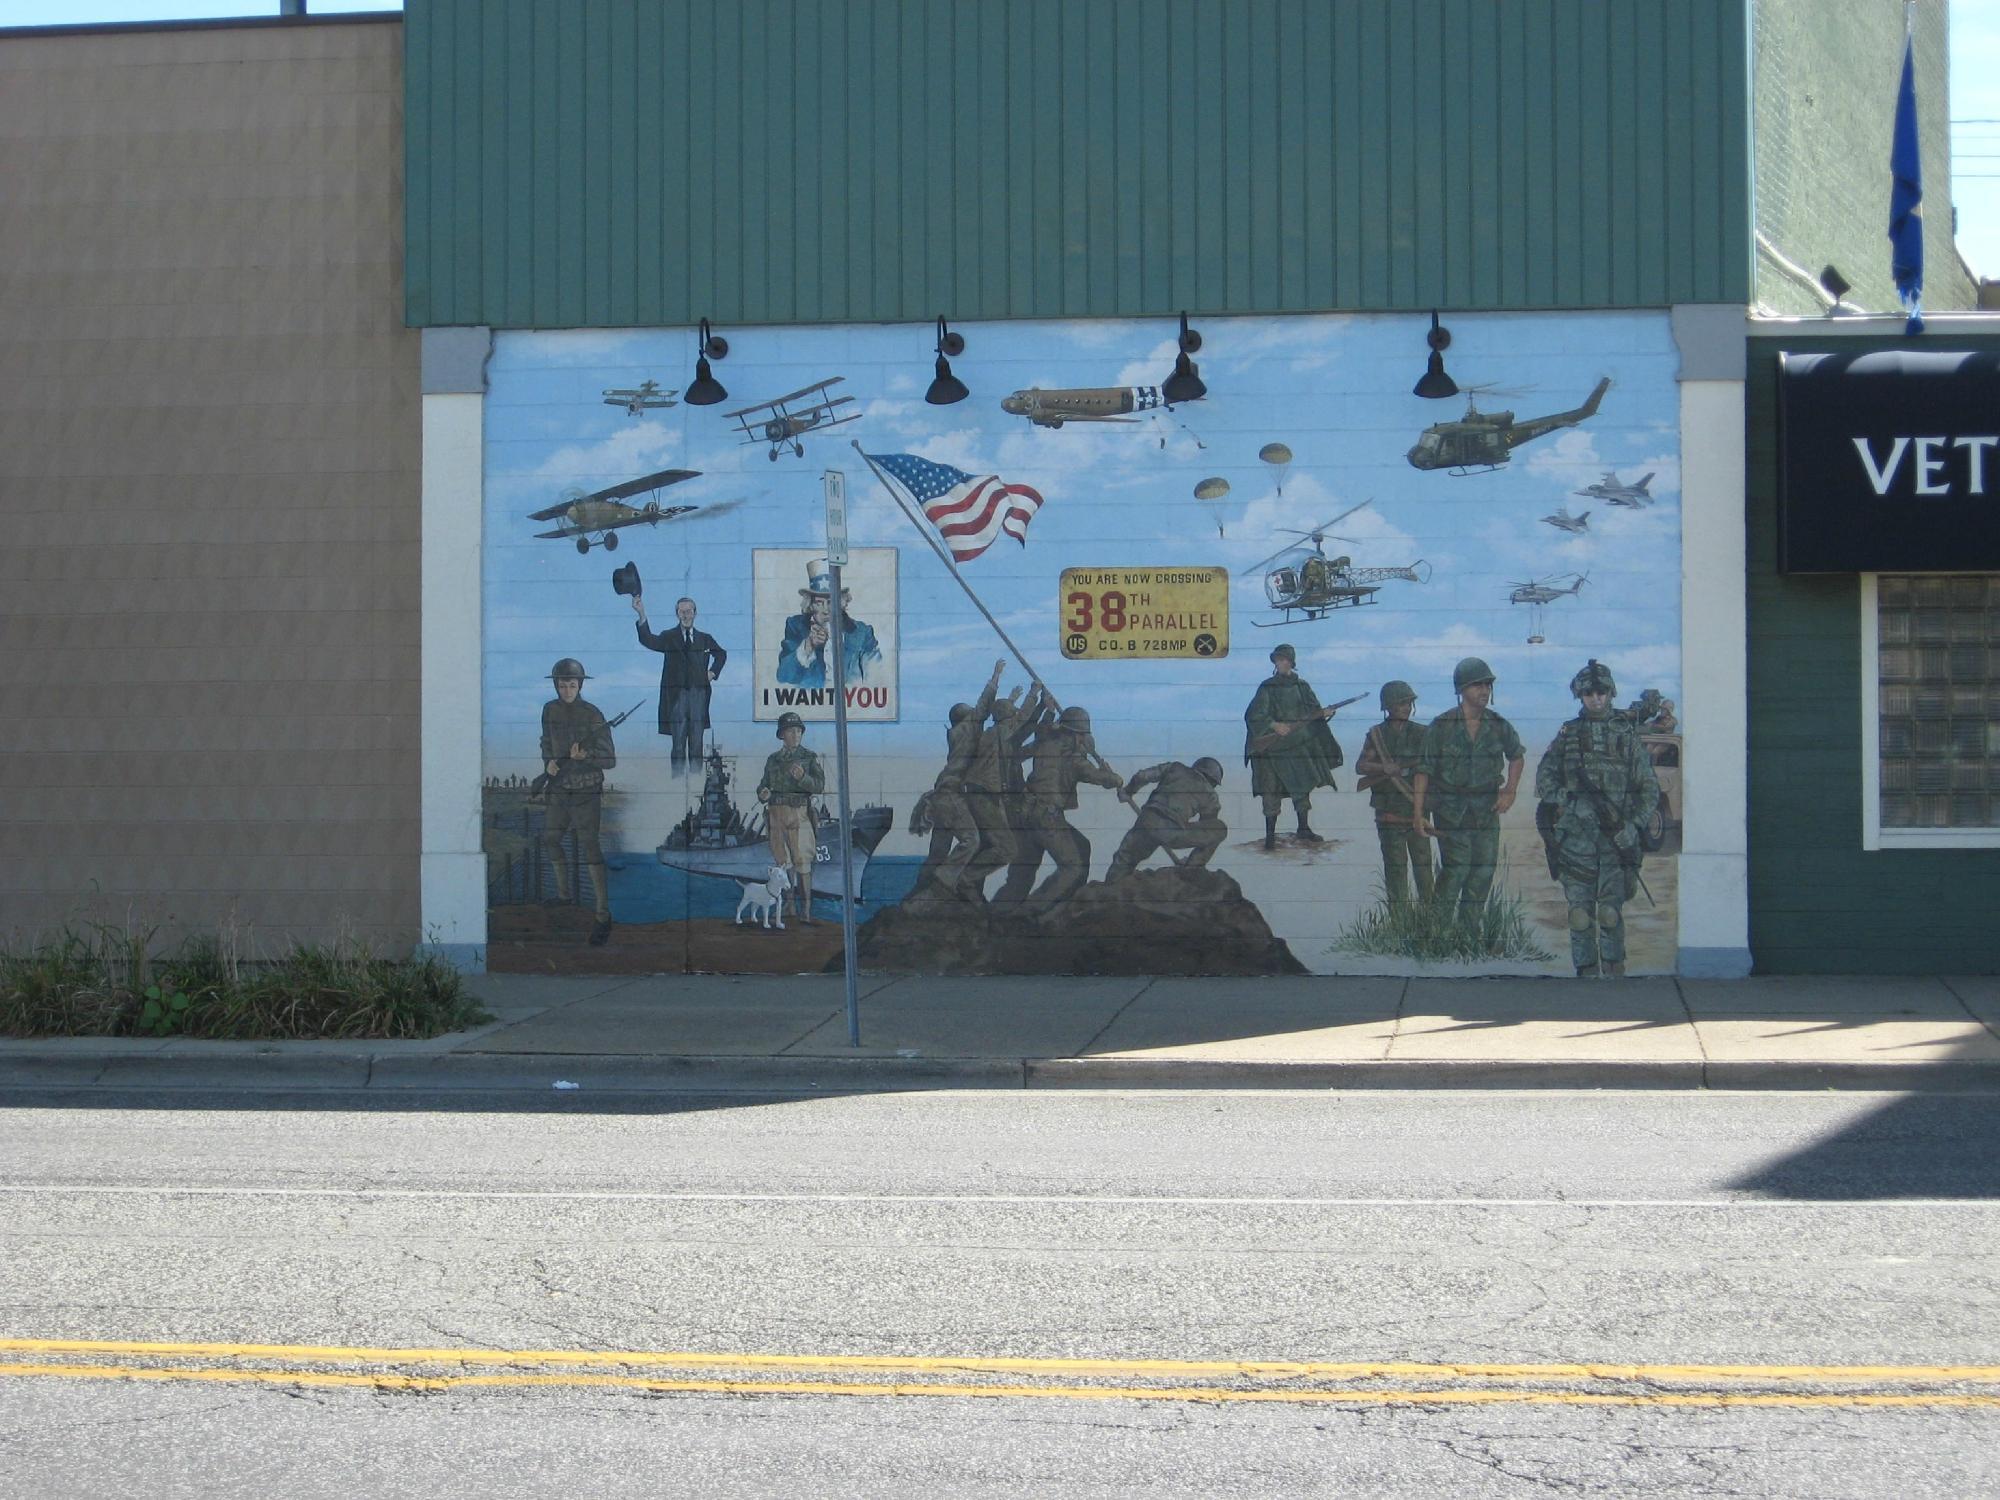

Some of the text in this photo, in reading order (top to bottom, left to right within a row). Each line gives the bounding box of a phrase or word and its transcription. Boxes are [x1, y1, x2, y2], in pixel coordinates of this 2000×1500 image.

[1852, 436, 1999, 495] VET
[1072, 573, 1212, 585] YOU ARE NOW CROSSING
[1130, 613, 1218, 630] PARALLEL
[1069, 638, 1086, 650] US
[1099, 640, 1123, 651] CO.
[1128, 640, 1136, 651] B
[763, 686, 888, 709] I WANT YOU
[815, 845, 831, 862] 63
